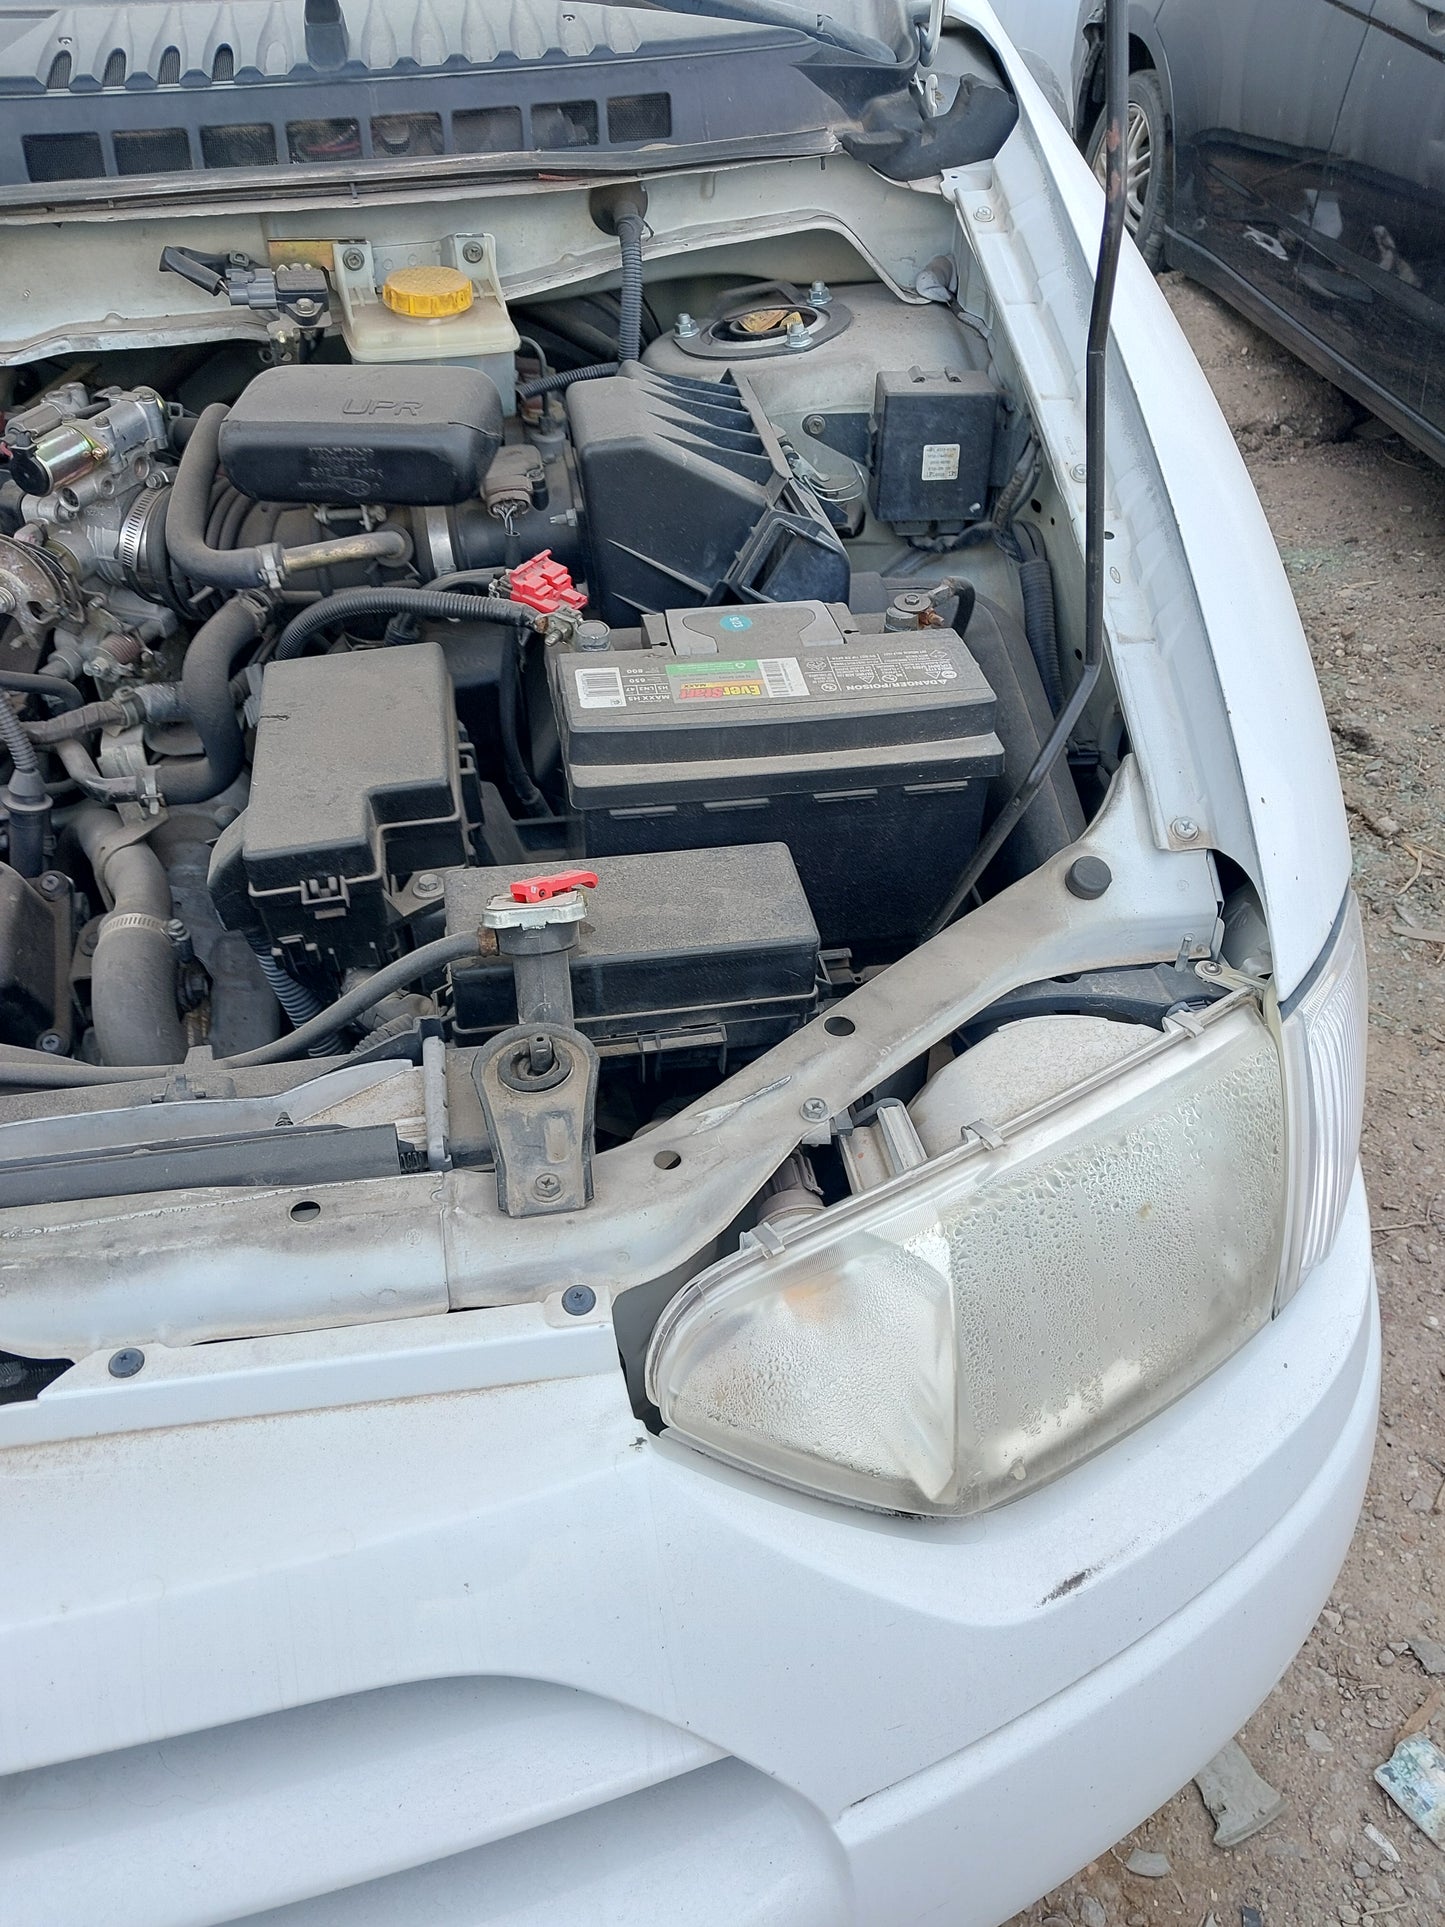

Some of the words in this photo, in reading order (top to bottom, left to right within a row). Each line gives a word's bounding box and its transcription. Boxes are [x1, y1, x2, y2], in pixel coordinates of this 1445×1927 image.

[342, 399, 424, 416] UPR
[680, 684, 762, 699] EverStart
[845, 679, 938, 691] DANGER/POISON
